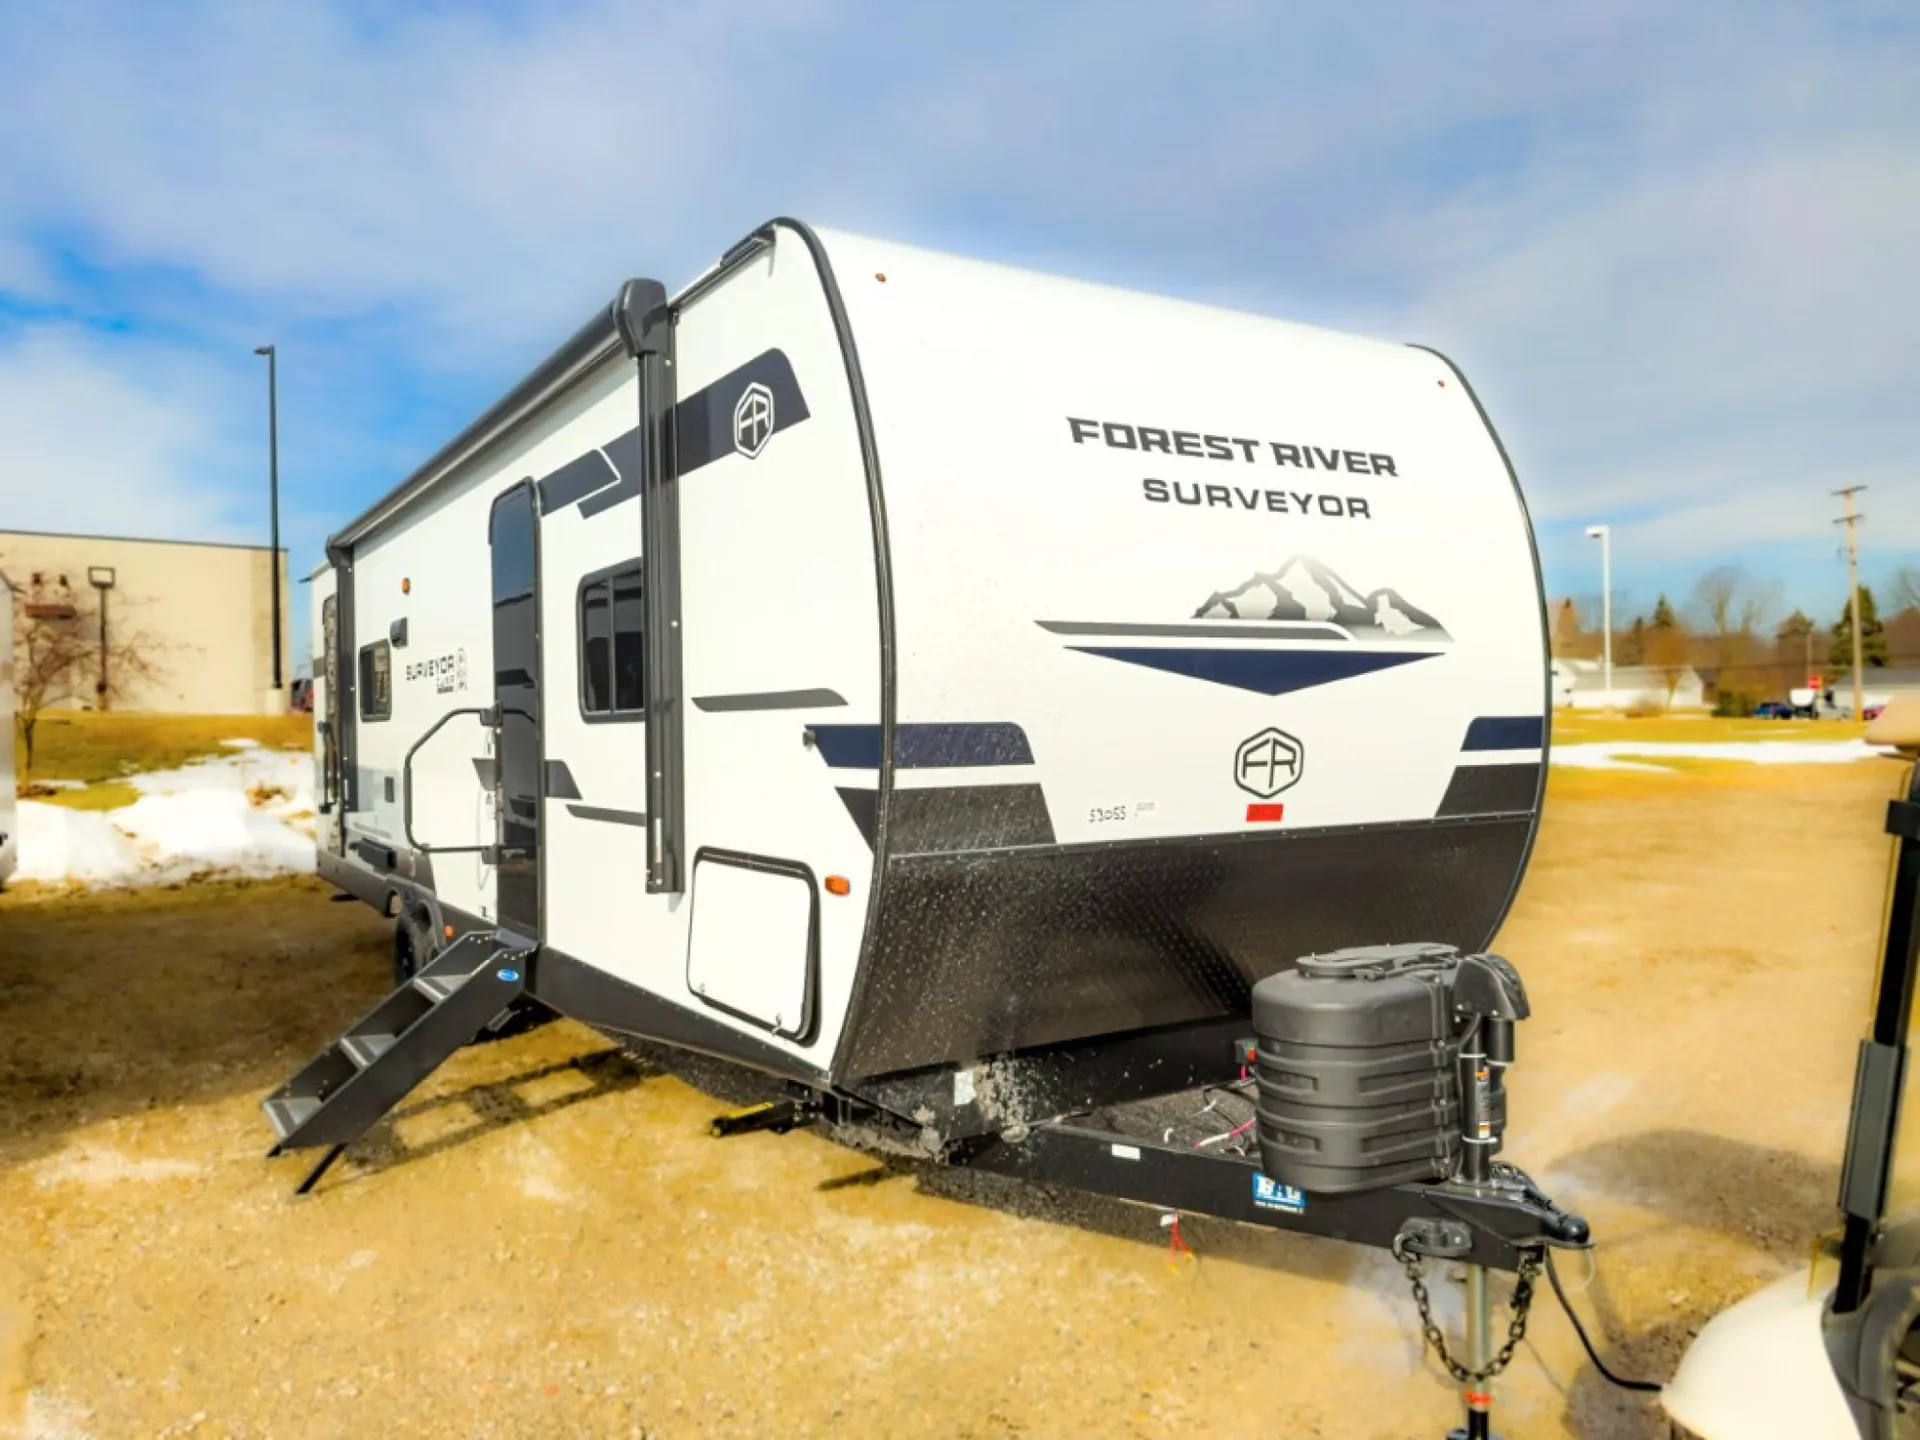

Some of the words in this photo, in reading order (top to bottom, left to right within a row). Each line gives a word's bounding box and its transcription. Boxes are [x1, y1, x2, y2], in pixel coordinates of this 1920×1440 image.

[1066, 416, 1260, 464] FOREST
[1268, 441, 1400, 478] RIVER
[1142, 477, 1372, 519] SURVEYOR
